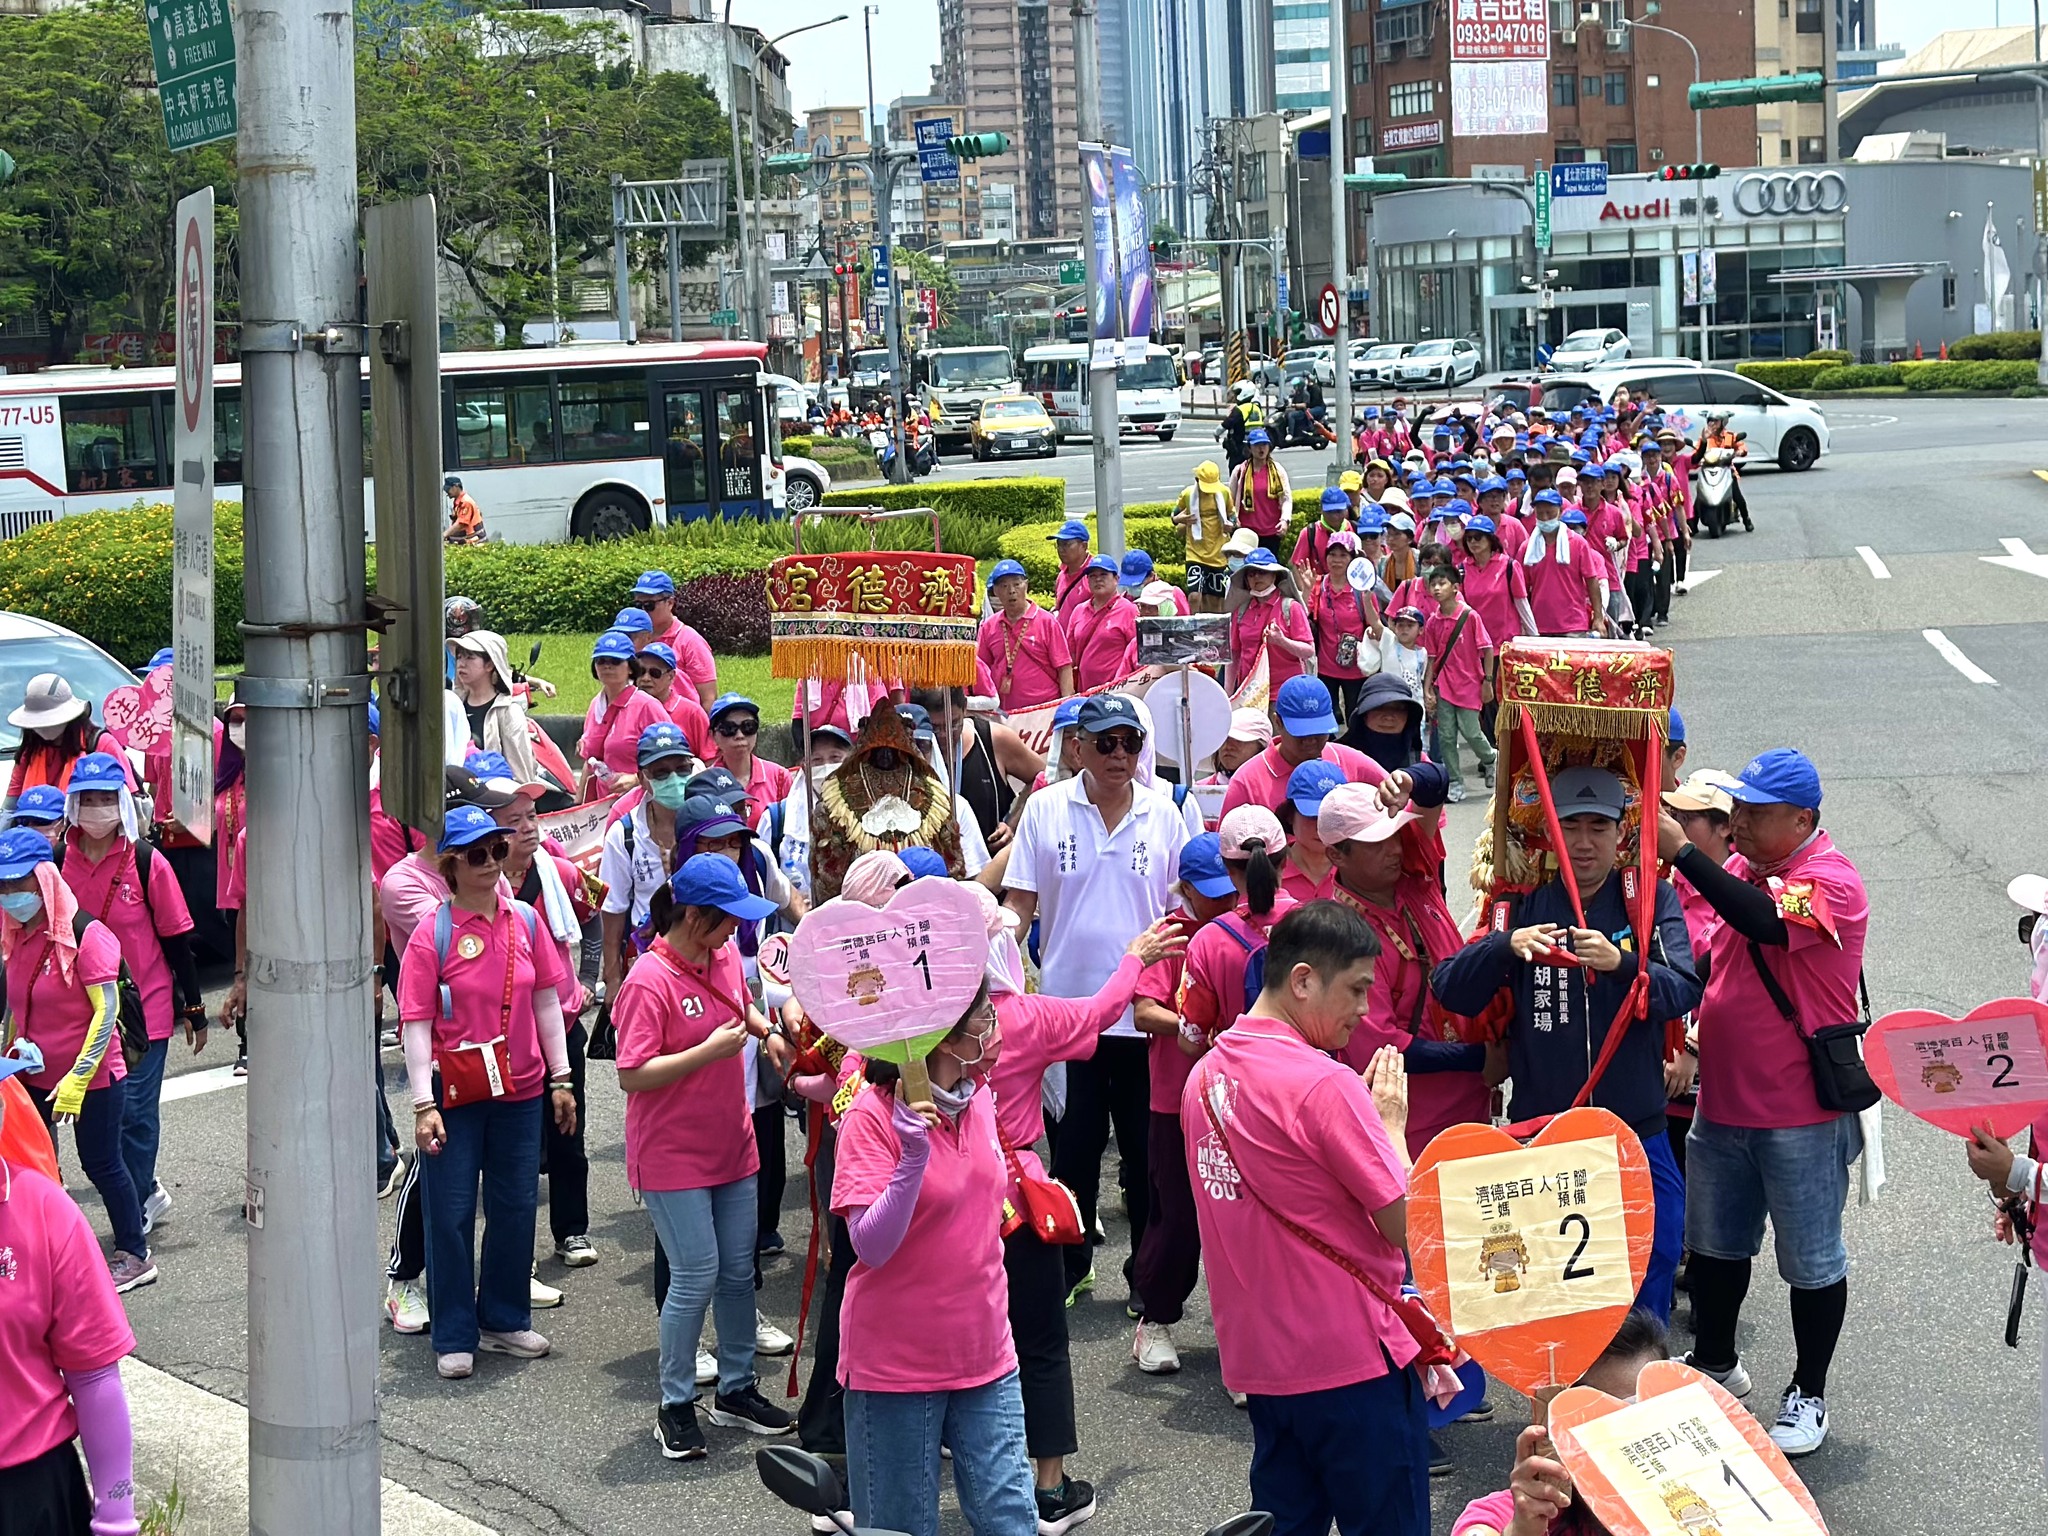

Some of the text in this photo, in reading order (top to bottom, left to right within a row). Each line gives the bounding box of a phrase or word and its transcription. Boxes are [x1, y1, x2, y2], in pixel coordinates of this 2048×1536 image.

[172, 0, 222, 39] 高速公路
[1456, 23, 1546, 44] 0933-047016
[184, 40, 217, 66] FREEWAY
[165, 75, 229, 120] 中央研究院
[1455, 86, 1545, 114] 0933-047-016
[170, 111, 233, 143] ACADEMIA SINICA
[1564, 167, 1607, 182] 臺北流行音樂中心
[1564, 182, 1607, 194] Taipei Music Center
[1599, 197, 1669, 220] Audi
[872, 248, 881, 269] P
[0, 405, 55, 427] 77-U5
[784, 561, 955, 615] 濟德宮
[1511, 662, 1664, 706] 濟德宮
[191, 763, 203, 806] 110
[545, 813, 609, 843] 祖精神一步一
[463, 937, 477, 958] 3
[840, 919, 931, 952] 濟德宮百人行腳
[907, 937, 931, 949] 預備
[846, 948, 870, 964] 二媽
[912, 949, 932, 991] 1
[682, 996, 704, 1016] 21
[1986, 1054, 2019, 1089] 2
[1198, 1145, 1234, 1167] MAZ
[1198, 1163, 1242, 1184] BLESS
[1475, 1168, 1588, 1205] 濟德宮百人行腳
[1481, 1200, 1511, 1221] 三媽
[1557, 1189, 1587, 1208] 預備
[1559, 1212, 1595, 1281] 2
[1720, 1458, 1774, 1522] 1
